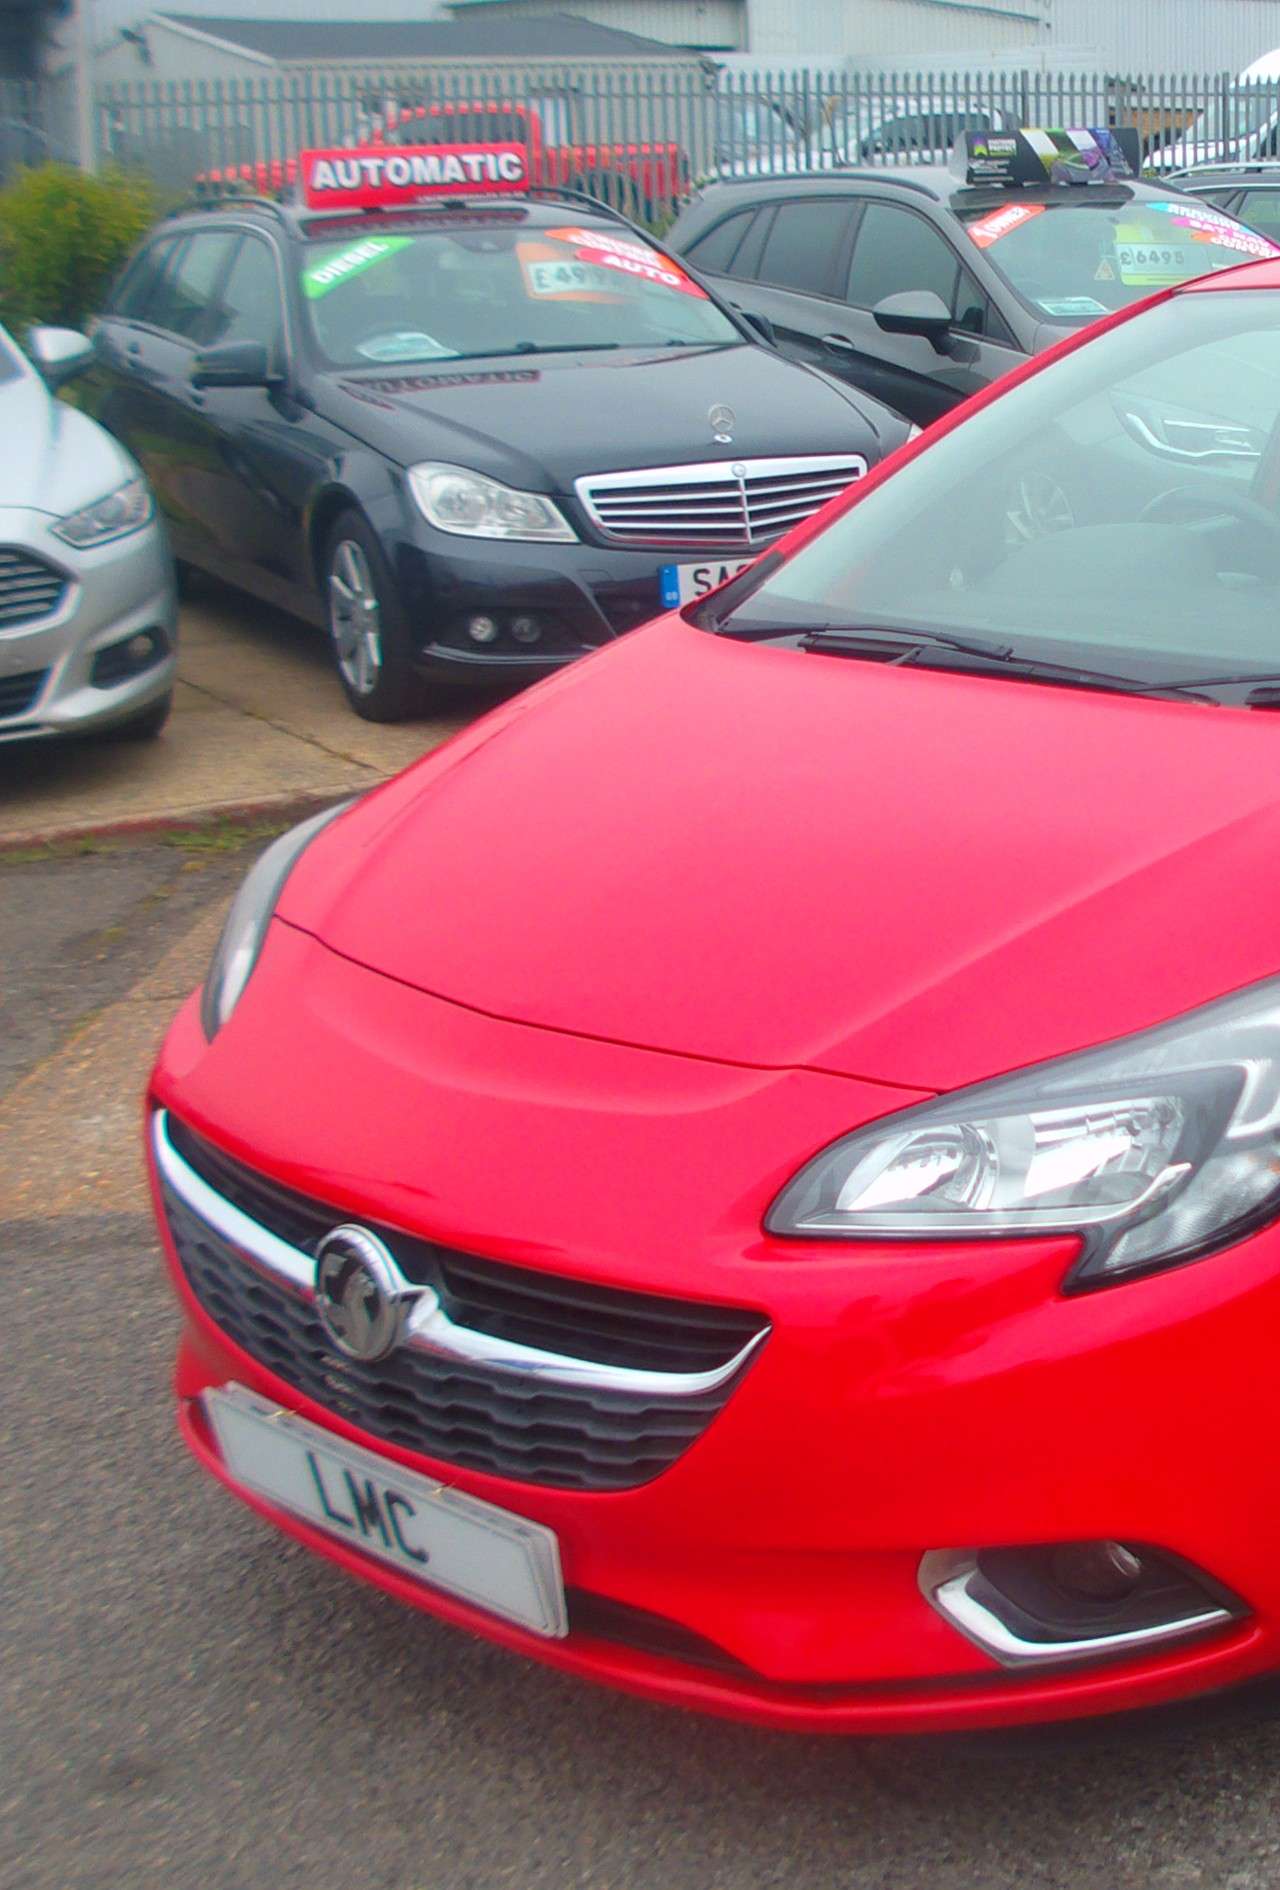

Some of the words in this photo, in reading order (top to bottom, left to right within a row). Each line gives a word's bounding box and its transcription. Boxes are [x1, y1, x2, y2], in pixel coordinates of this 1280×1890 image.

[312, 151, 524, 190] AUTOMATIC
[602, 255, 681, 286] AUTO
[692, 563, 750, 597] SA
[306, 1450, 430, 1564] LMC
